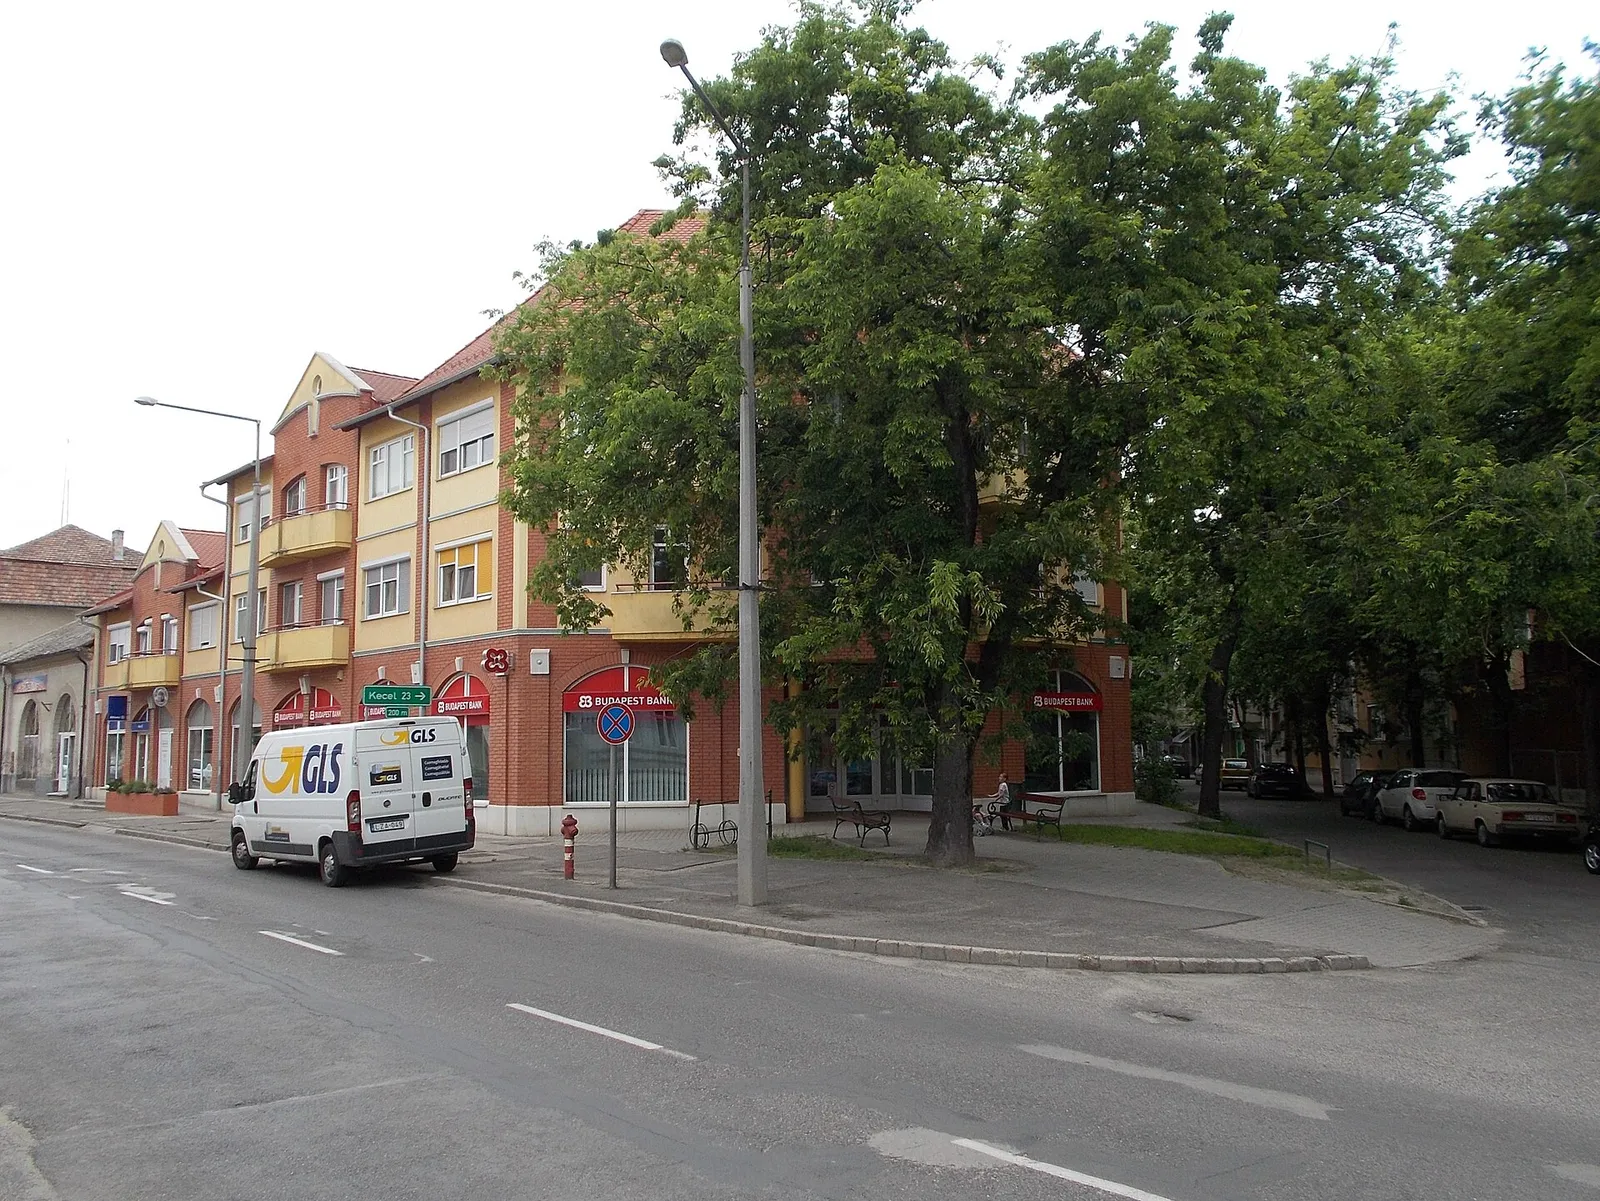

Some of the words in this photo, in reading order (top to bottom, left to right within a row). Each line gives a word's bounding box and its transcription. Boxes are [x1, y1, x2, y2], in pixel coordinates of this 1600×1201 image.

[368, 691, 397, 700] Kecel
[401, 691, 411, 700] 23
[595, 696, 645, 705] BUDAPEST
[445, 701, 469, 711] BUDAPEST
[469, 700, 483, 709] BANK
[1043, 697, 1076, 706] BUDAPEST
[1076, 697, 1094, 706] BANK
[411, 728, 436, 743] GLS
[302, 743, 343, 794] GLS
